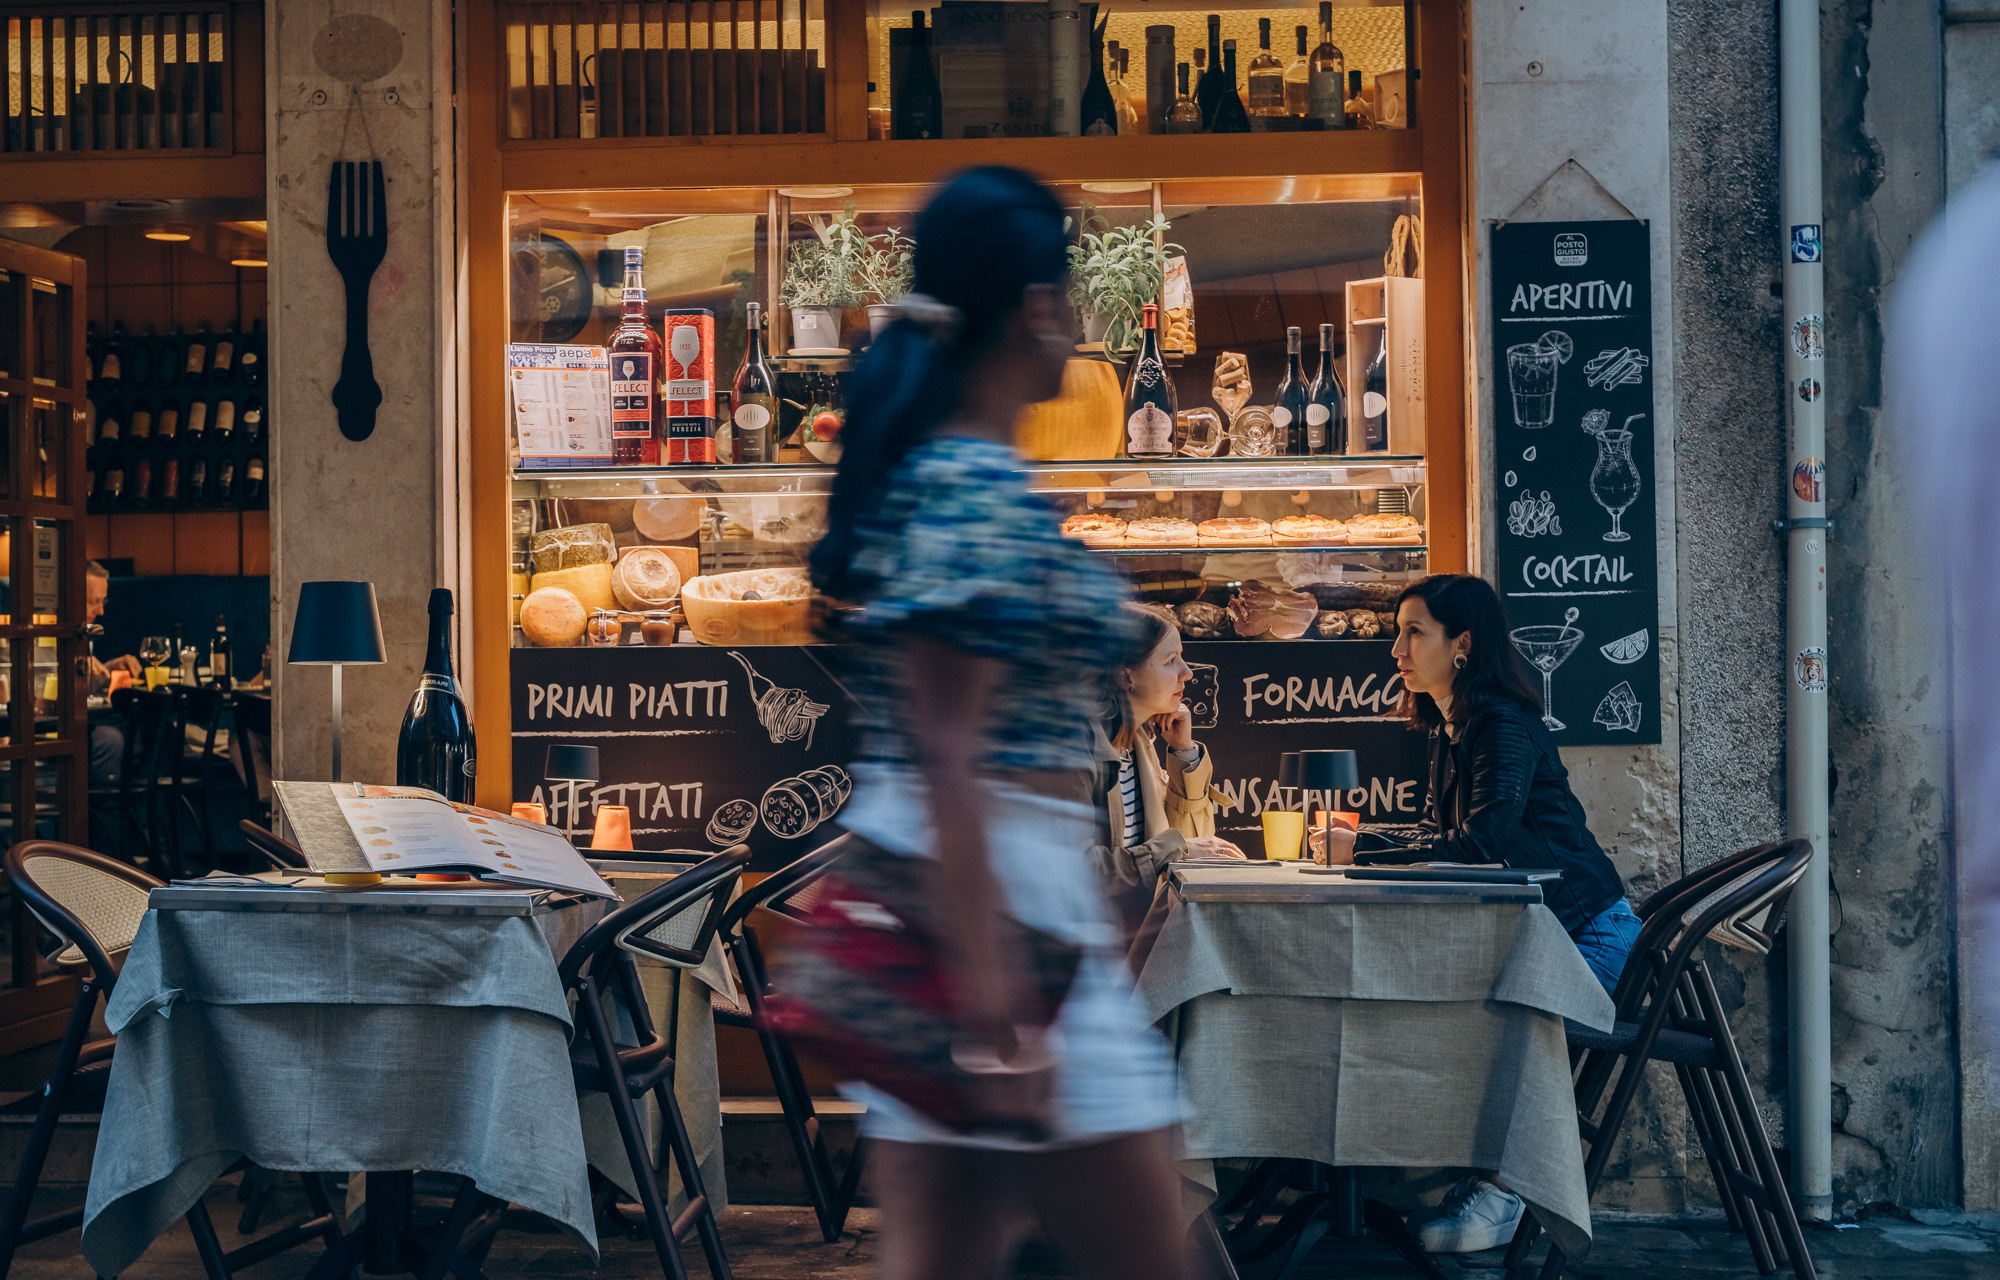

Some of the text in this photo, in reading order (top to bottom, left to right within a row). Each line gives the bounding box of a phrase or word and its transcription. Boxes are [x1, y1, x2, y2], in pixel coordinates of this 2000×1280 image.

[1510, 280, 1632, 312] APERITIVI
[679, 343, 691, 351] 1920
[613, 383, 649, 393] SELECT
[670, 386, 703, 395] SELECT
[1523, 554, 1633, 588] COCKTAIL
[1794, 648, 1811, 666] TOBIA
[527, 680, 729, 720] PRIMI PIATTI
[1242, 673, 1405, 718] FORMAGG
